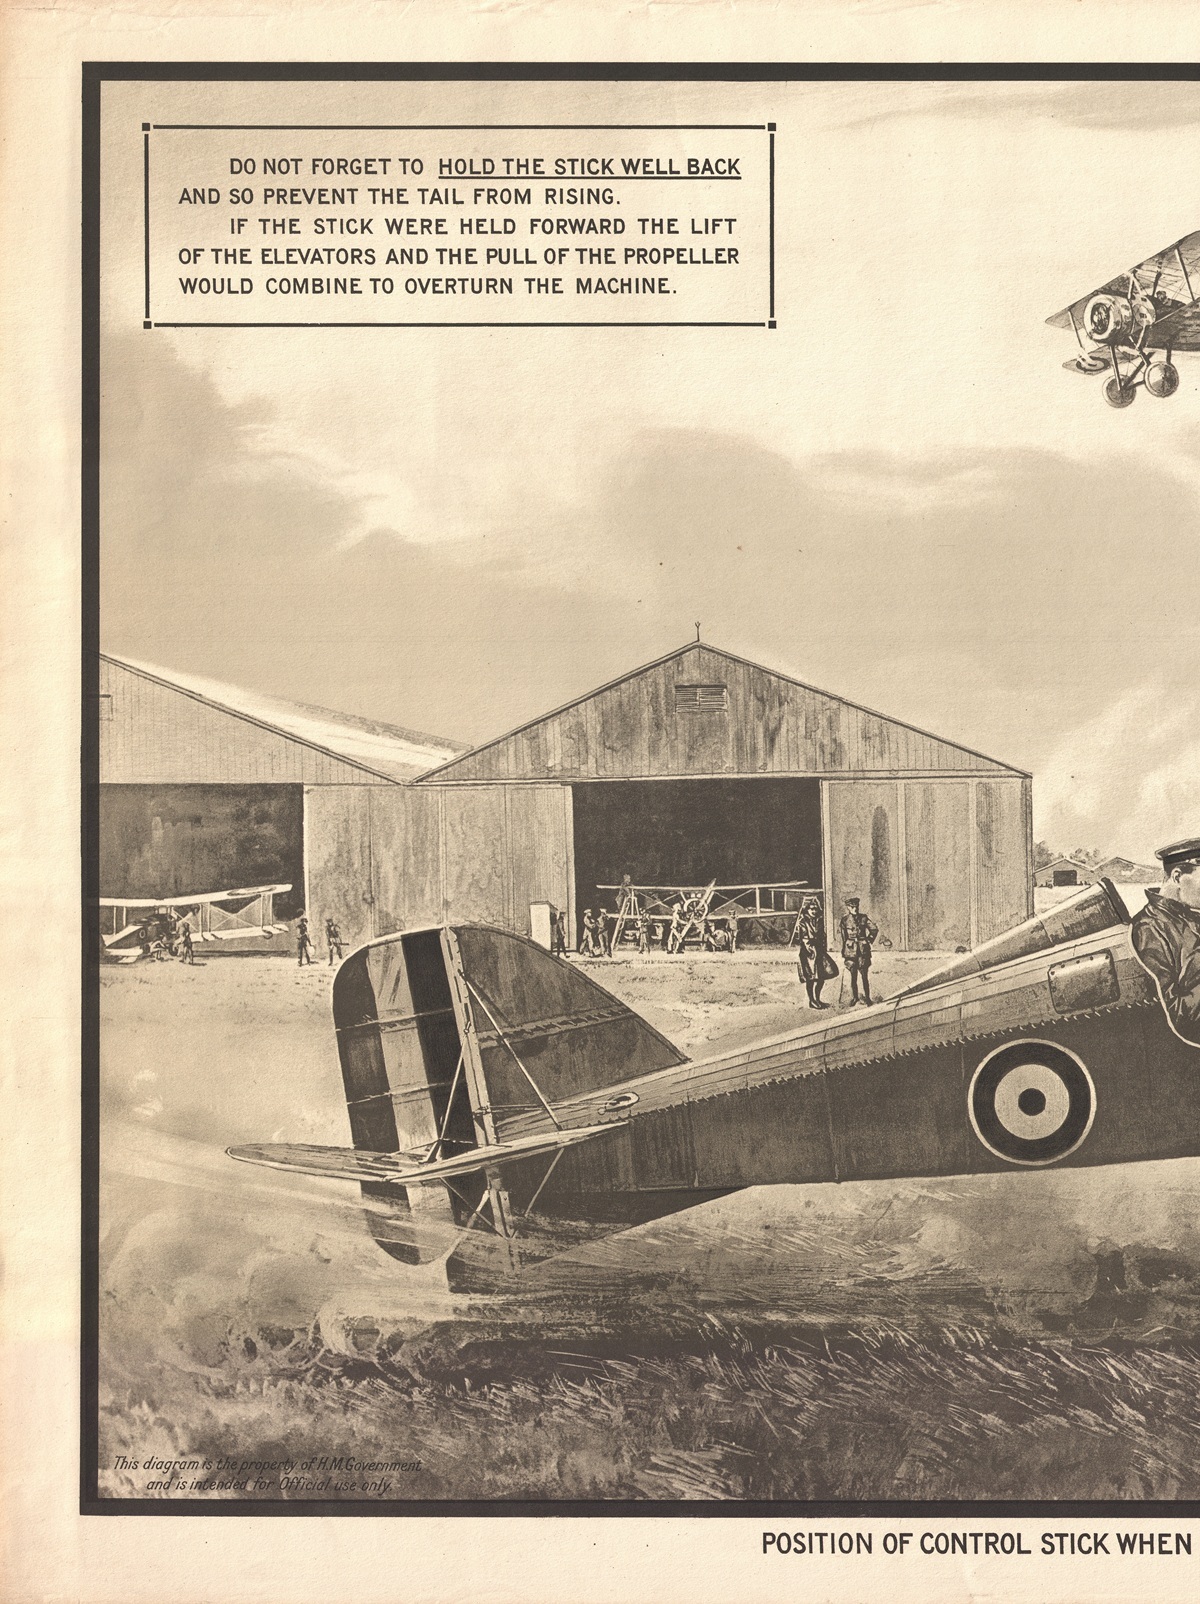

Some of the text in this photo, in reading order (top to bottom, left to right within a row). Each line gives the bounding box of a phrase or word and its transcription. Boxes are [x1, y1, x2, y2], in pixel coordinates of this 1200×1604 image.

[229, 157, 741, 176] DO NOT FORGET TO HOLD THE STICK WELL BACK
[178, 187, 621, 205] AND SO PREVENT THE TAIL FROM RISING.
[230, 217, 737, 235] IF THE STICK WERE HELD FORWARD THE LIFT
[178, 247, 740, 265] OF THE ELEVATORS AND THE PULL OF THE PROPELLER
[178, 277, 677, 295] WOULD COMBINE TO OVERTURN THE MACHINE.
[113, 1455, 139, 1470] This
[142, 1455, 199, 1474] diagram
[201, 1457, 213, 1470] is
[216, 1457, 238, 1471] the
[239, 1458, 298, 1475] property
[300, 1457, 317, 1471] of
[146, 1476, 393, 1496] and is intended for Official use only.
[762, 1532, 873, 1556] POSITION
[882, 1532, 914, 1556] OF
[919, 1532, 1032, 1556] CONTROL
[1041, 1532, 1111, 1556] STICK
[1115, 1532, 1192, 1556] WHEN
